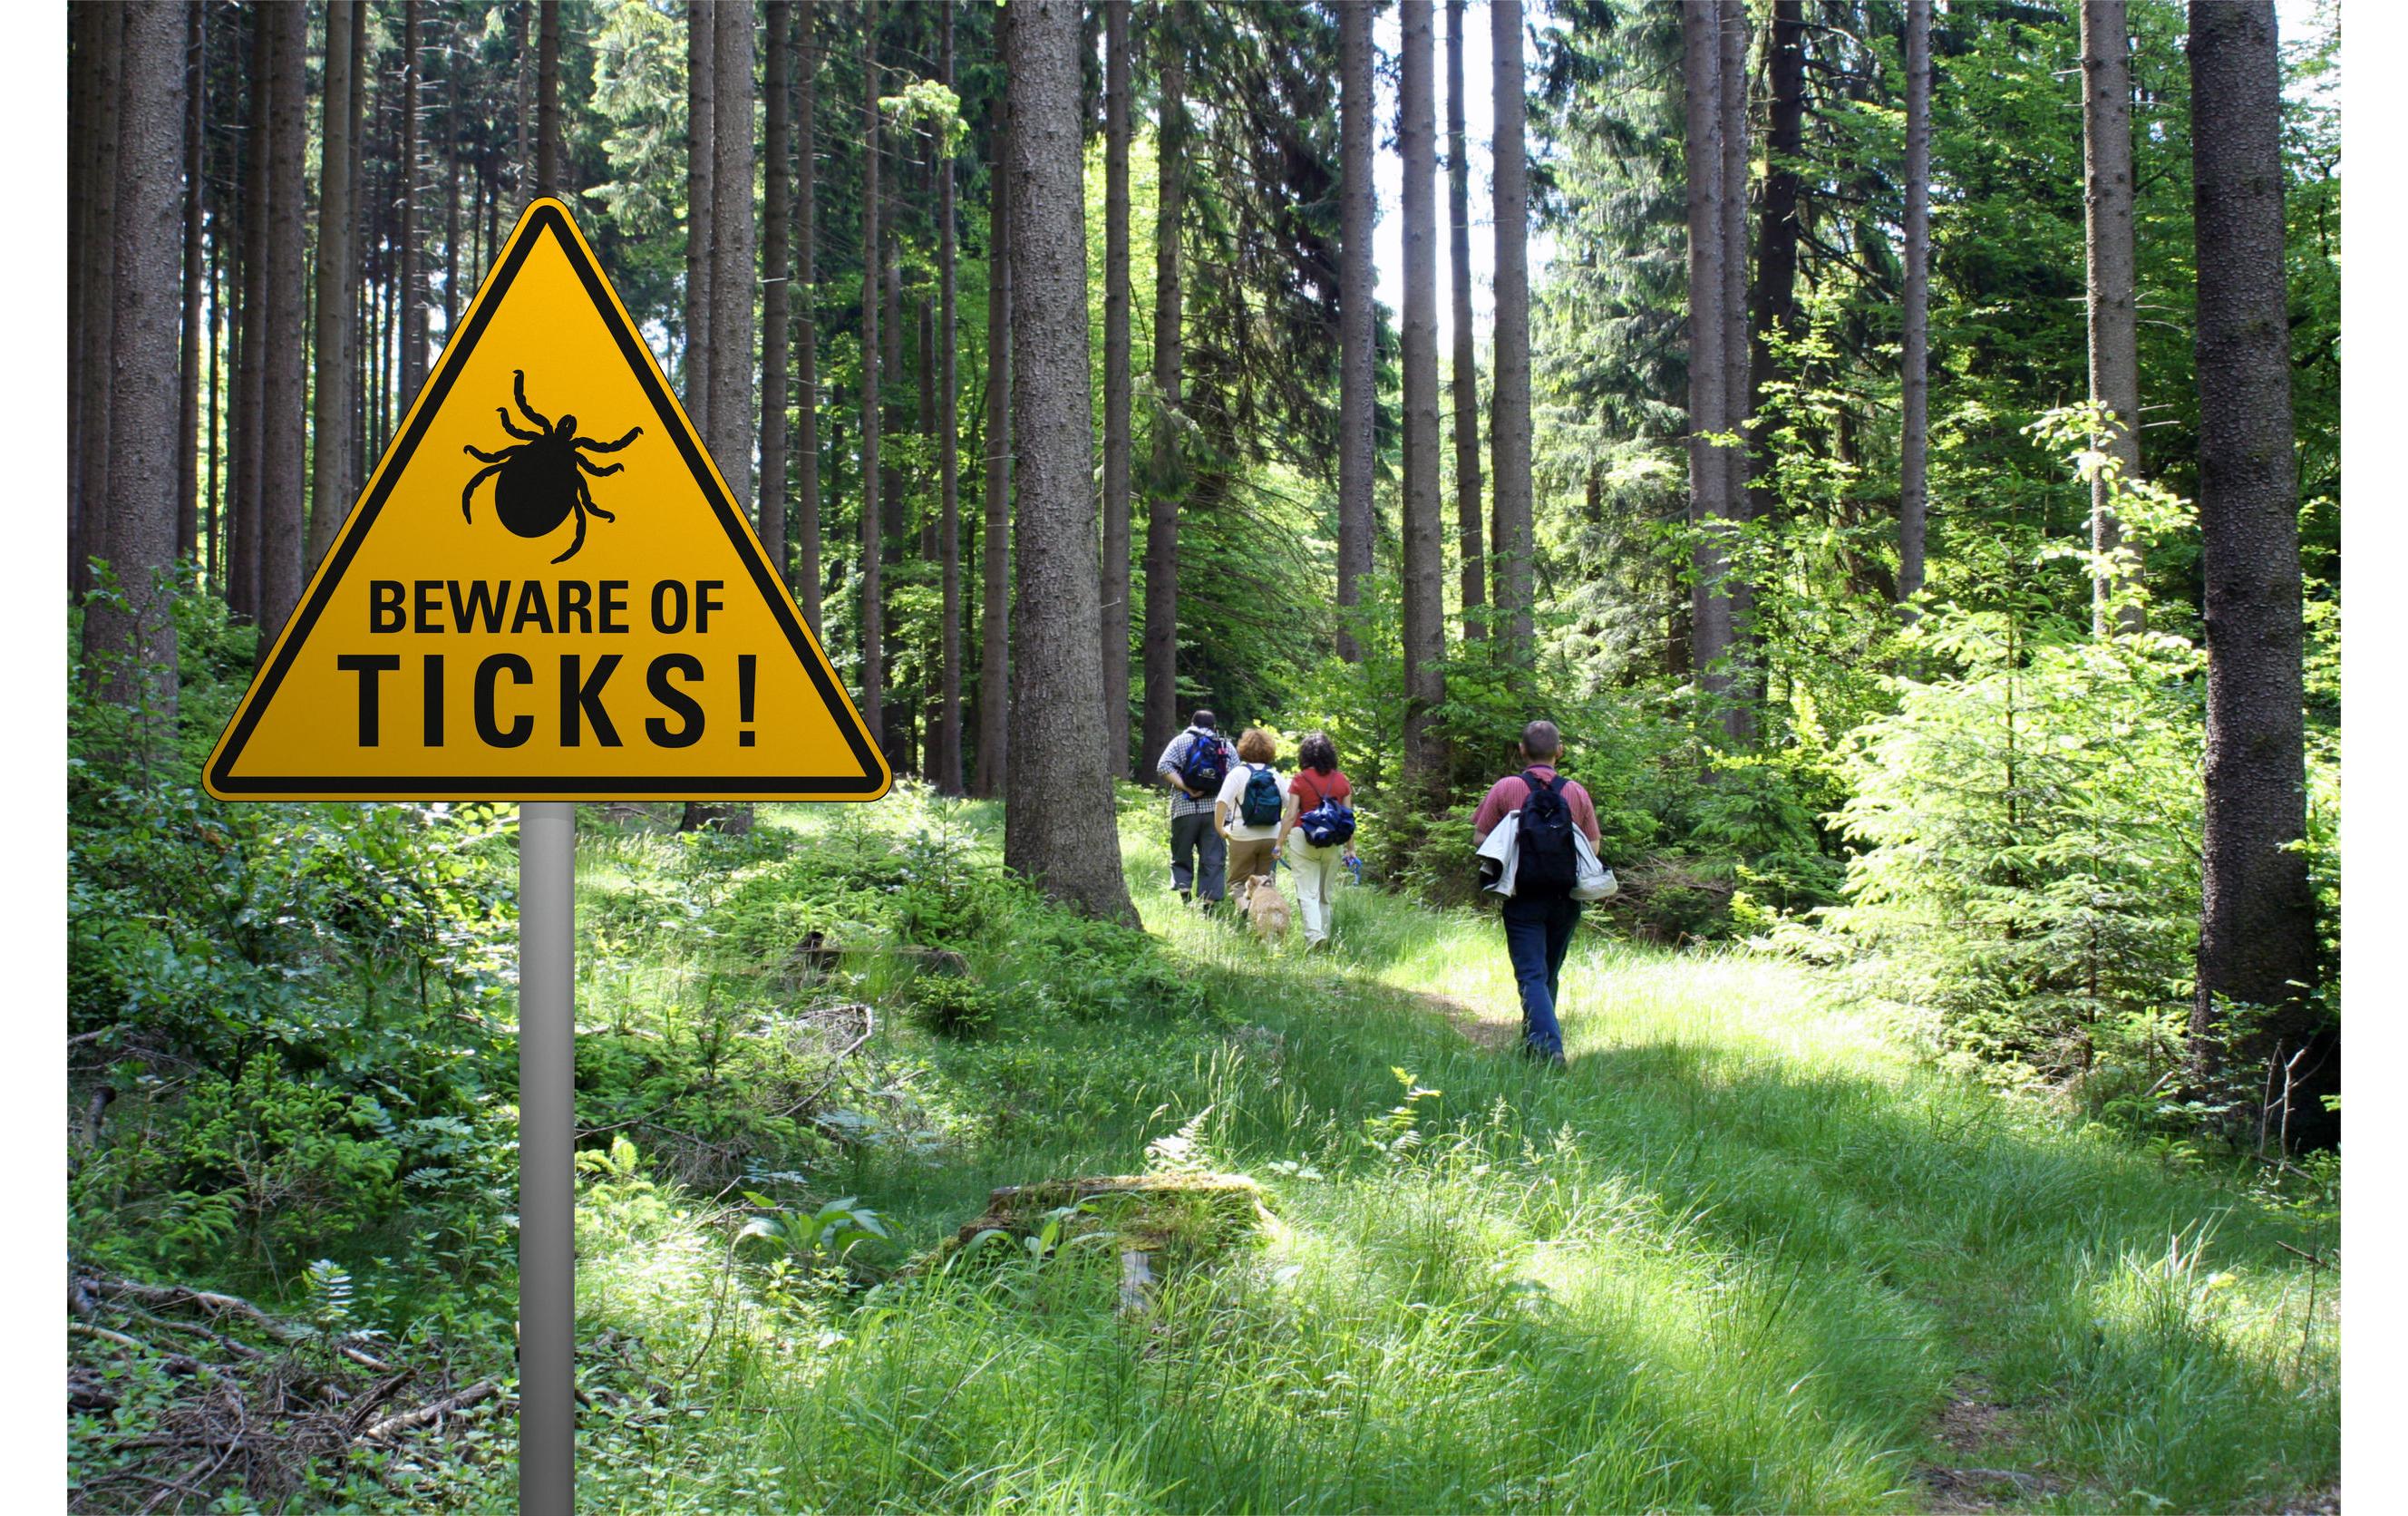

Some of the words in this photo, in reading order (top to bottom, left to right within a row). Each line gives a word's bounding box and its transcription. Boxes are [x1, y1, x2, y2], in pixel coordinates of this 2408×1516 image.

[370, 579, 629, 634] BEWARE
[650, 579, 724, 635] OF
[336, 653, 757, 749] TICKS!
